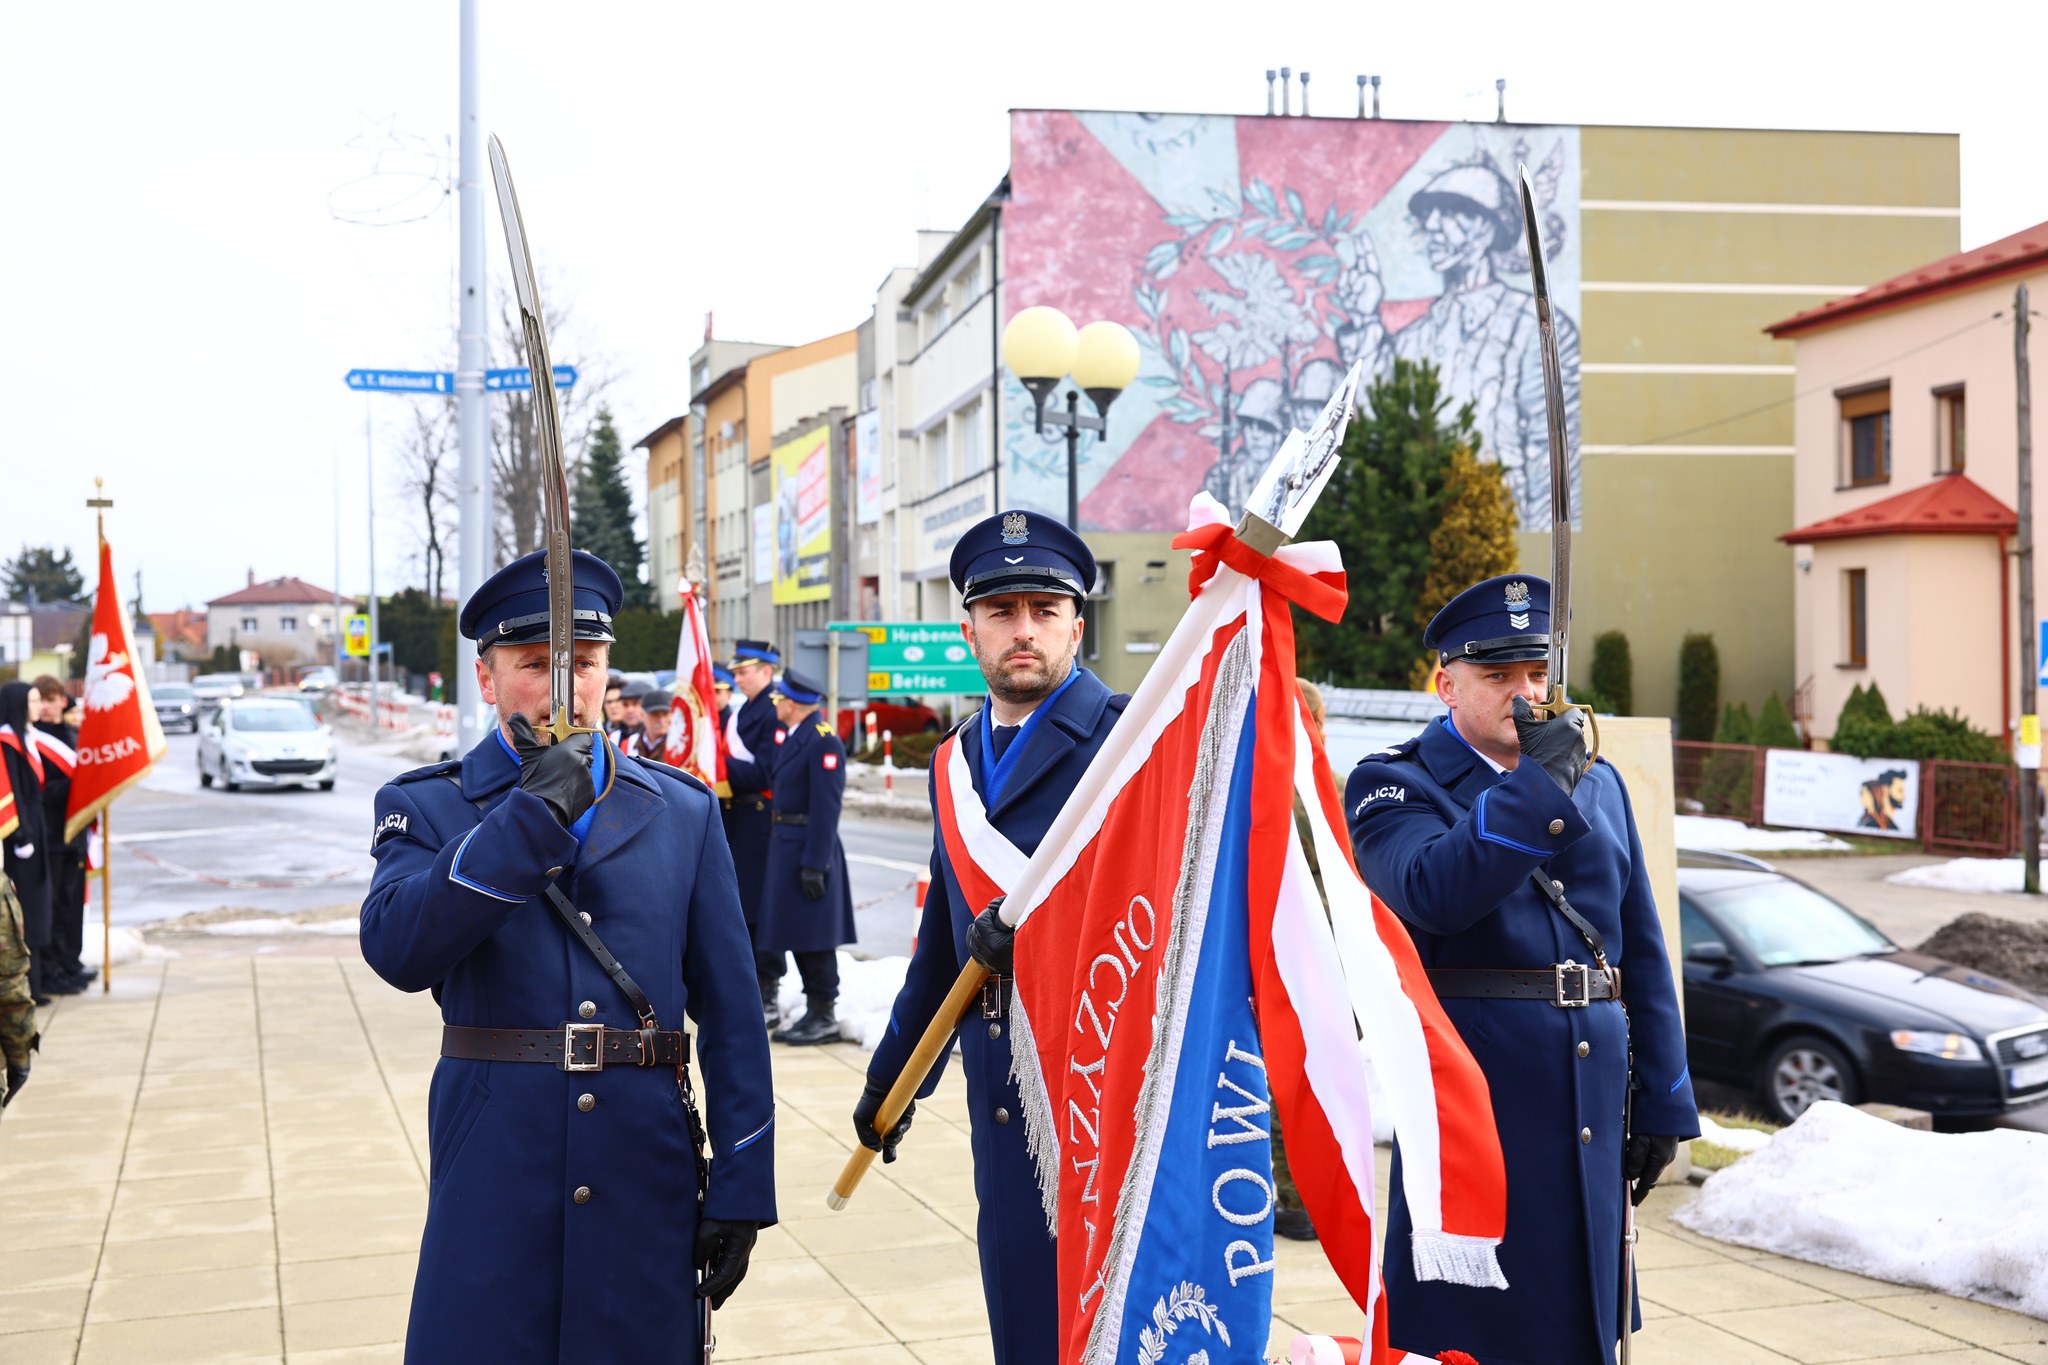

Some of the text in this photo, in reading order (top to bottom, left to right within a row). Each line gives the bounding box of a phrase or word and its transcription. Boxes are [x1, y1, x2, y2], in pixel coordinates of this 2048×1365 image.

[892, 628, 965, 643] Hrebenn
[77, 736, 142, 766] OLSKA
[1355, 786, 1406, 816] POLICJA
